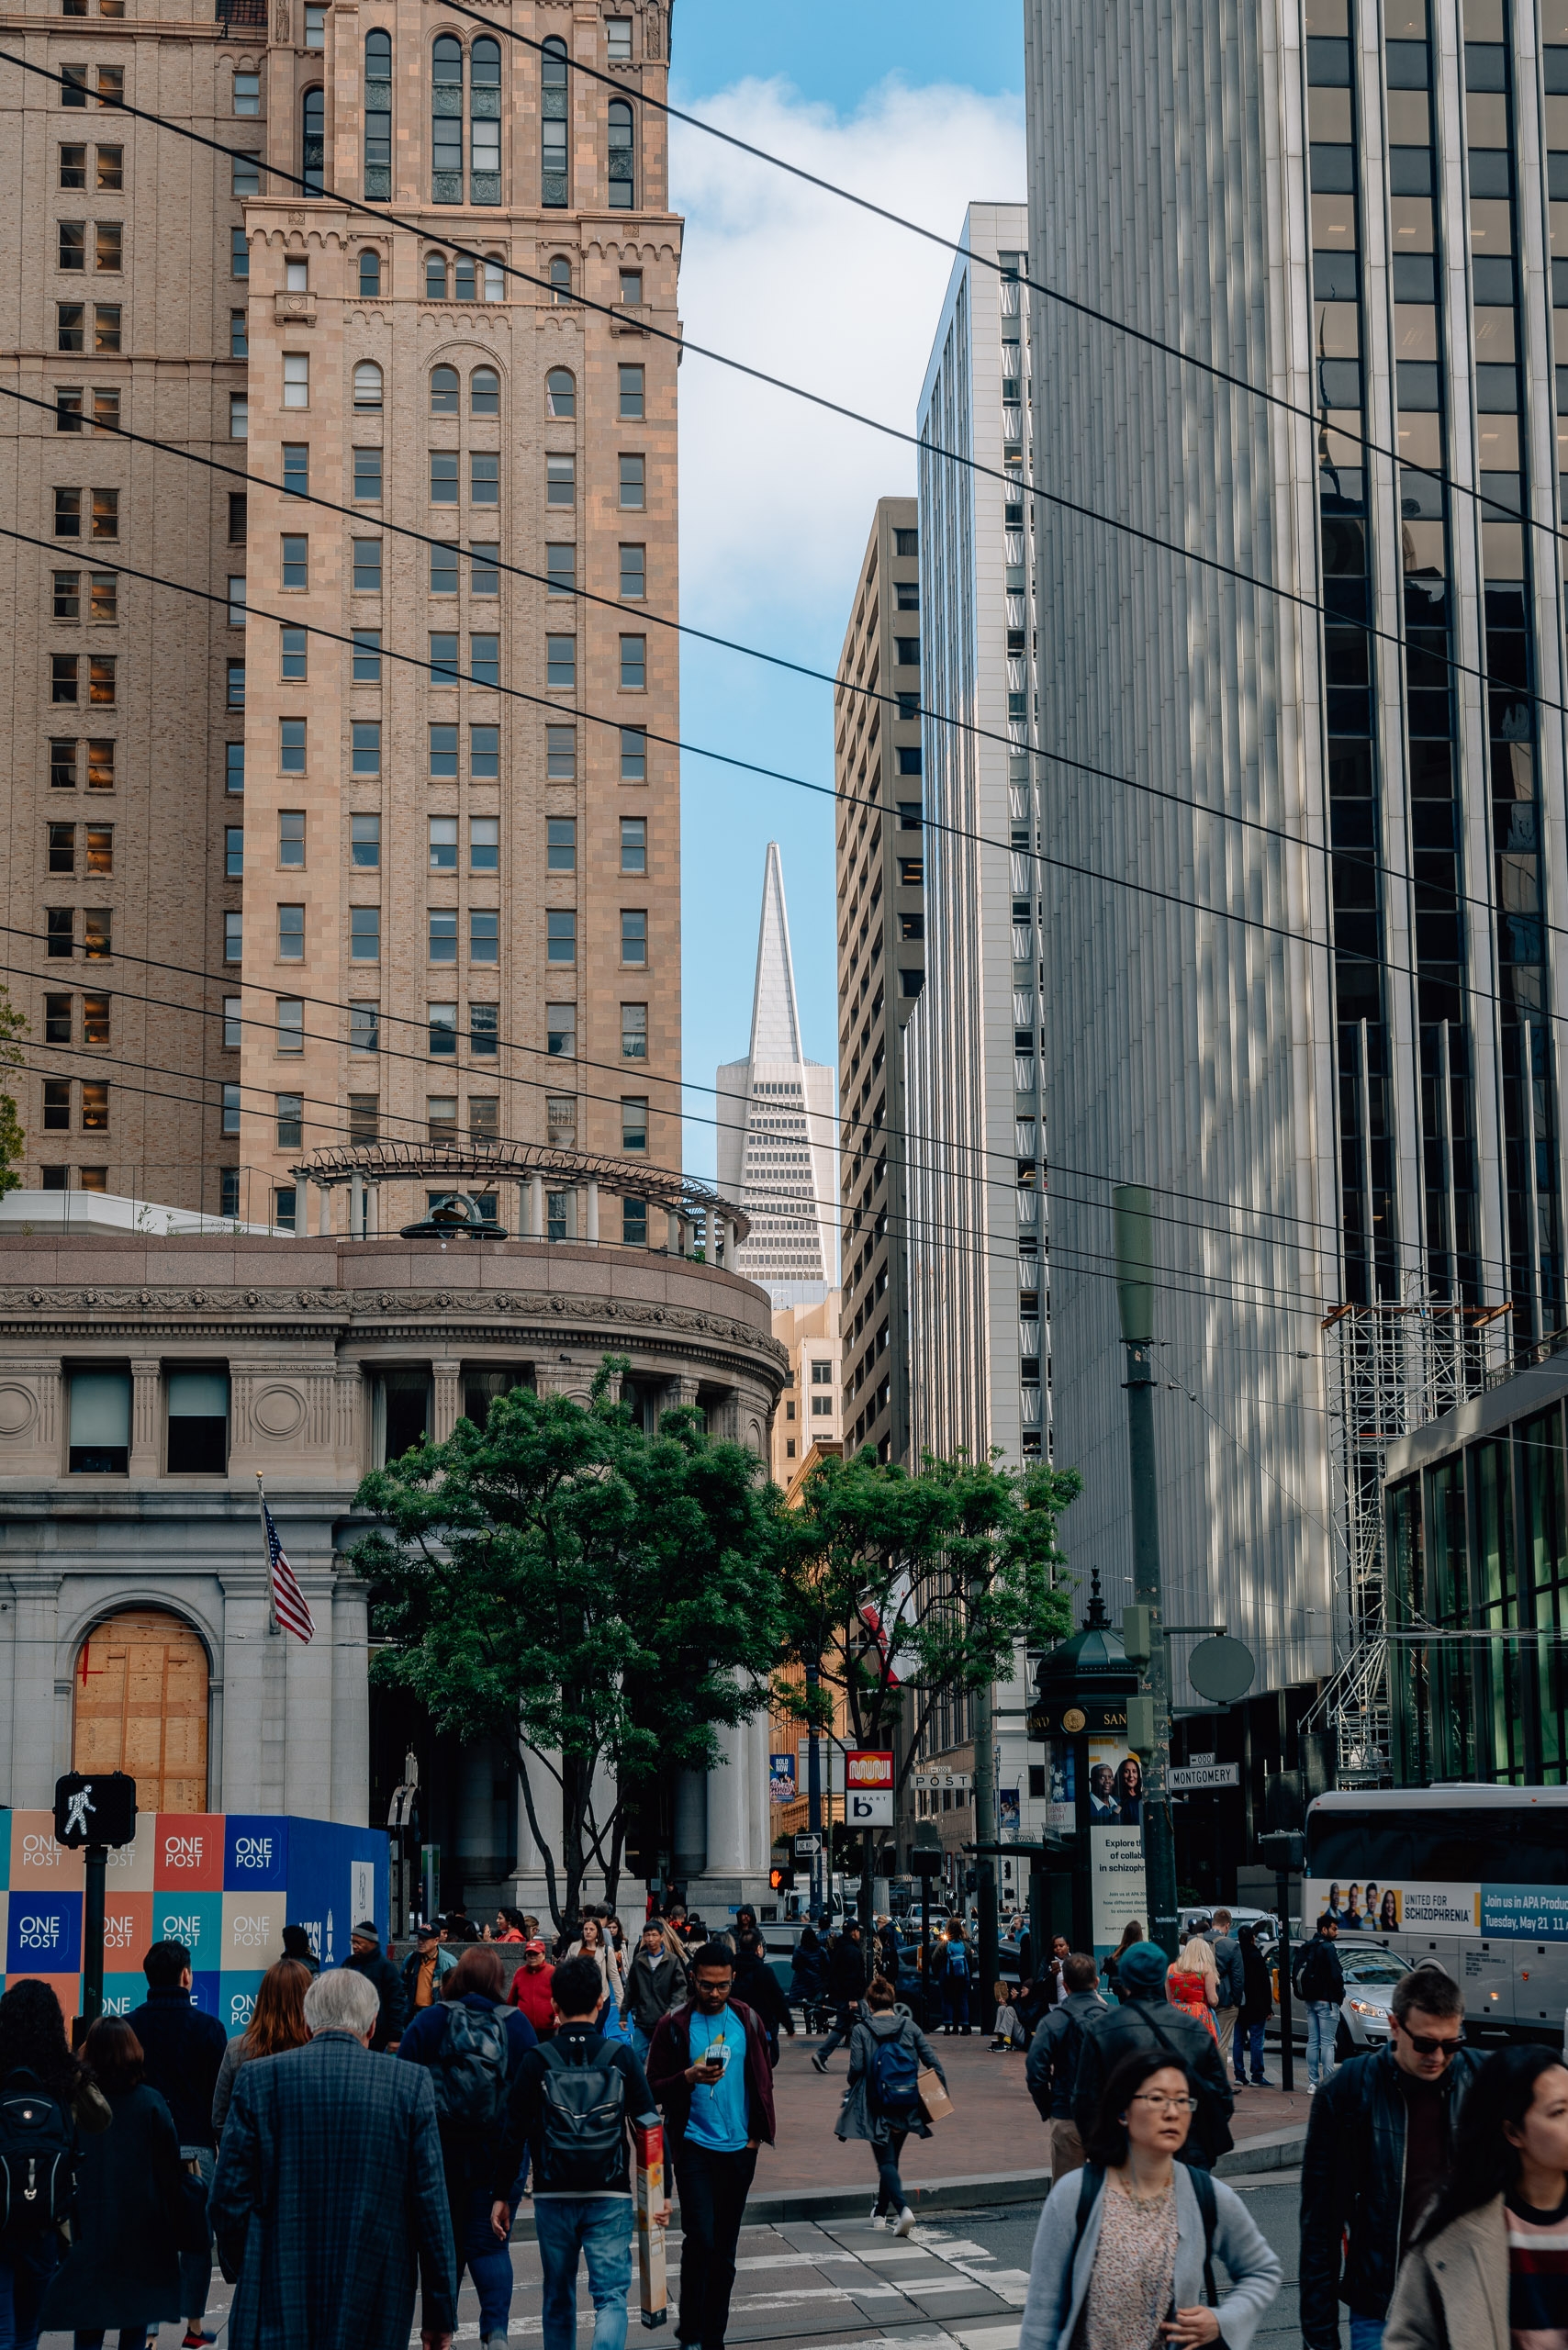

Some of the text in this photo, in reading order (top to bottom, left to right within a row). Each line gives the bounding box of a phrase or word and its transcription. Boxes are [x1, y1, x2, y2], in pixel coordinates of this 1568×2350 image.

[1103, 1713, 1127, 1725] SAN
[1198, 1755, 1211, 1763] 000
[849, 1760, 890, 1780] MUNI
[1173, 1768, 1231, 1785] MONTGOMERY
[916, 1776, 967, 1786] POST
[165, 1837, 203, 1853] ONE
[236, 1838, 272, 1854] ONE
[805, 1841, 813, 1850] WAY
[1105, 1840, 1135, 1849] Explore
[23, 1852, 62, 1866] POST
[107, 1853, 136, 1866] OST
[165, 1854, 202, 1867] POST
[236, 1855, 272, 1868] POST
[1099, 1863, 1106, 1872] in
[1405, 1894, 1447, 1906] UNITED FOR
[1484, 1895, 1501, 1908] Join
[1503, 1897, 1513, 1908] us
[1514, 1896, 1521, 1908] in
[1523, 1896, 1539, 1908] APA
[1405, 1908, 1469, 1921] SCHIZOPHRENIA
[19, 1916, 60, 1933] ONE
[162, 1916, 200, 1932] ONE
[233, 1916, 270, 1932] ONE
[1484, 1914, 1518, 1930] Tuesday,
[1519, 1916, 1537, 1931] May
[1538, 1917, 1549, 1930] 21
[1553, 1917, 1564, 1930] 11
[20, 1934, 59, 1948] POST
[104, 1934, 132, 1948] OST
[234, 1933, 269, 1946] POST
[230, 1994, 257, 2011] ON
[231, 2011, 252, 2025] PO
